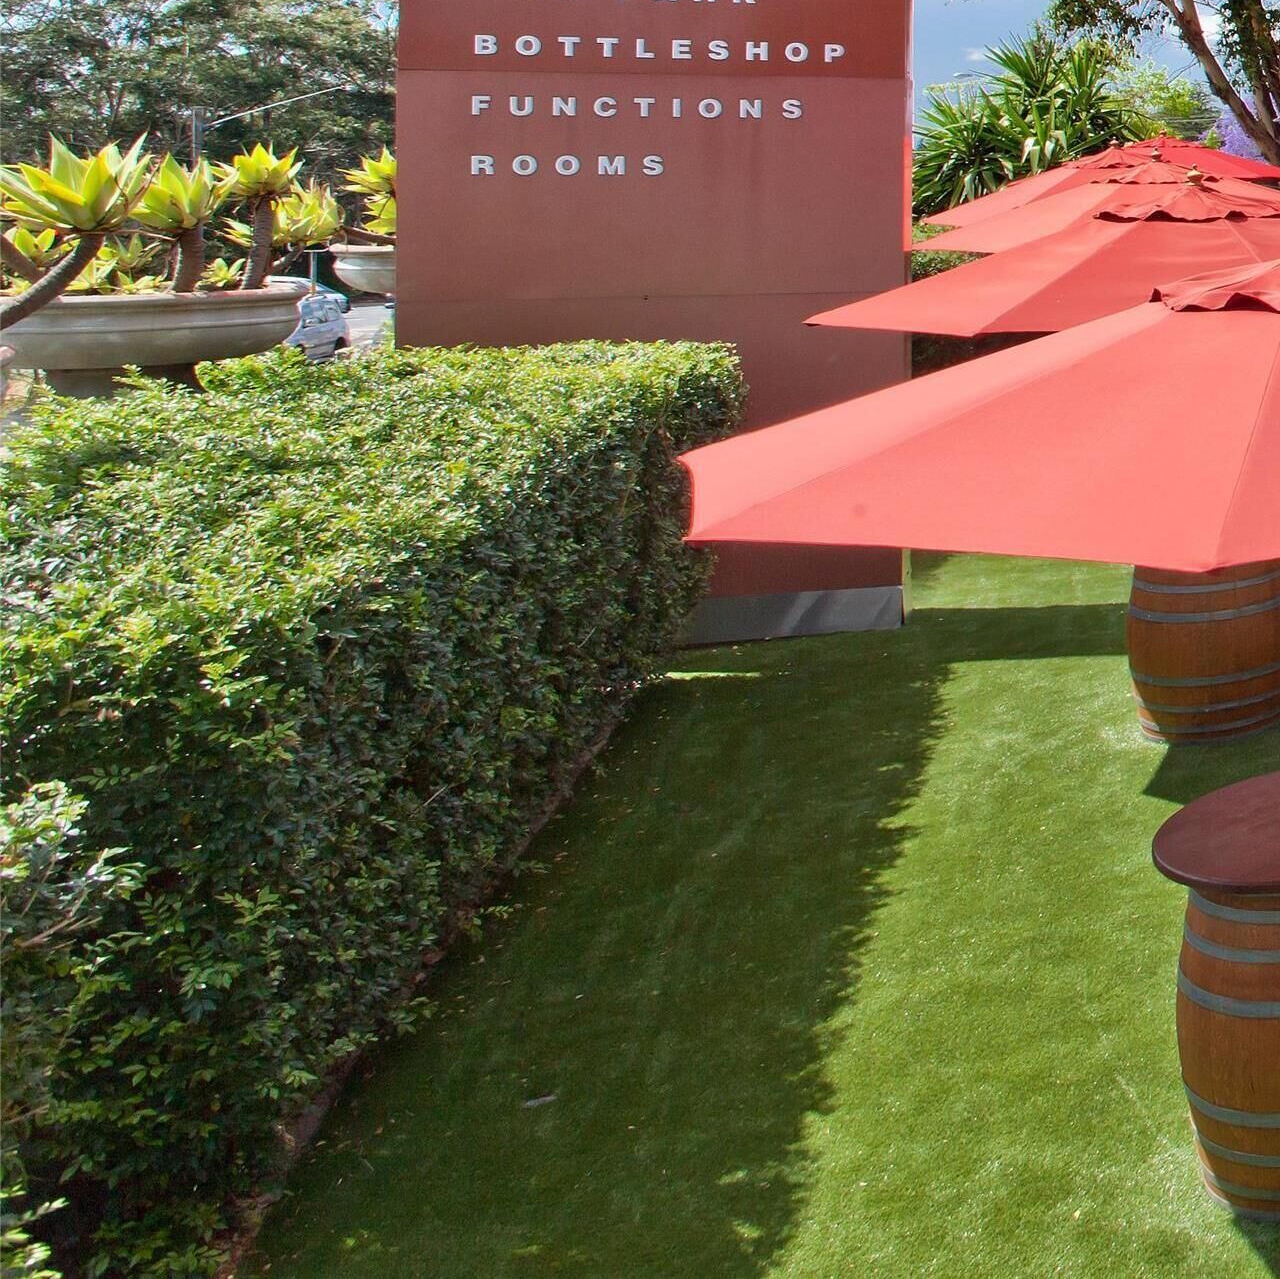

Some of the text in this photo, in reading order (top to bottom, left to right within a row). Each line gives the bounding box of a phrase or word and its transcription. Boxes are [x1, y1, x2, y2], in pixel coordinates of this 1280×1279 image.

[474, 34, 844, 63] BOTTLESHOP
[471, 95, 802, 119] FUNCTIONS
[470, 155, 664, 176] ROOMS
